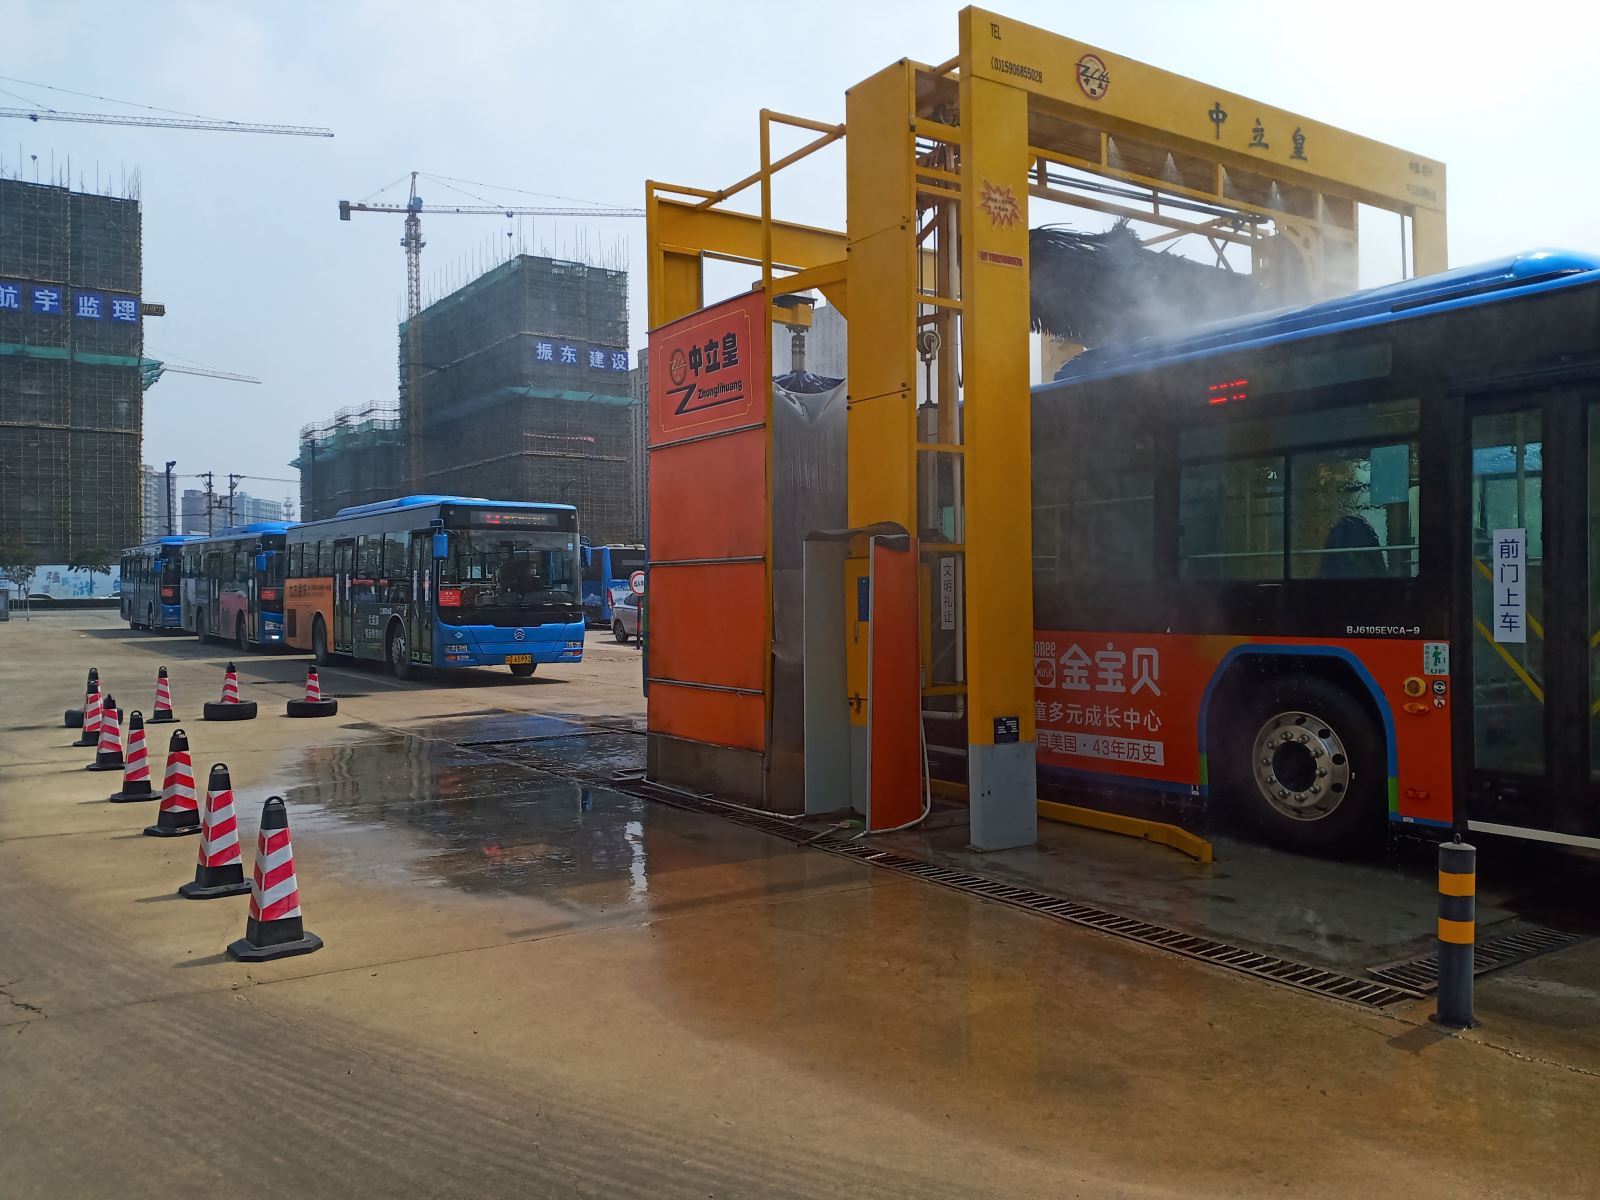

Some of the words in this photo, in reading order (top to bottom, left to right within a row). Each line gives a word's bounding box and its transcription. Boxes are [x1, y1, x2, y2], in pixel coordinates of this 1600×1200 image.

[990, 23, 1002, 41] TEL
[1208, 101, 1309, 162] 中立皇
[0, 285, 137, 322] 航宇监理
[536, 342, 627, 371] 振东建设
[689, 332, 739, 377] 中立皇
[1499, 538, 1520, 633] 前门上车
[1346, 625, 1421, 635] BJ6105EVCA-9
[1059, 642, 1162, 697] 金宝贝
[1034, 700, 1162, 732] 童多元成长中心
